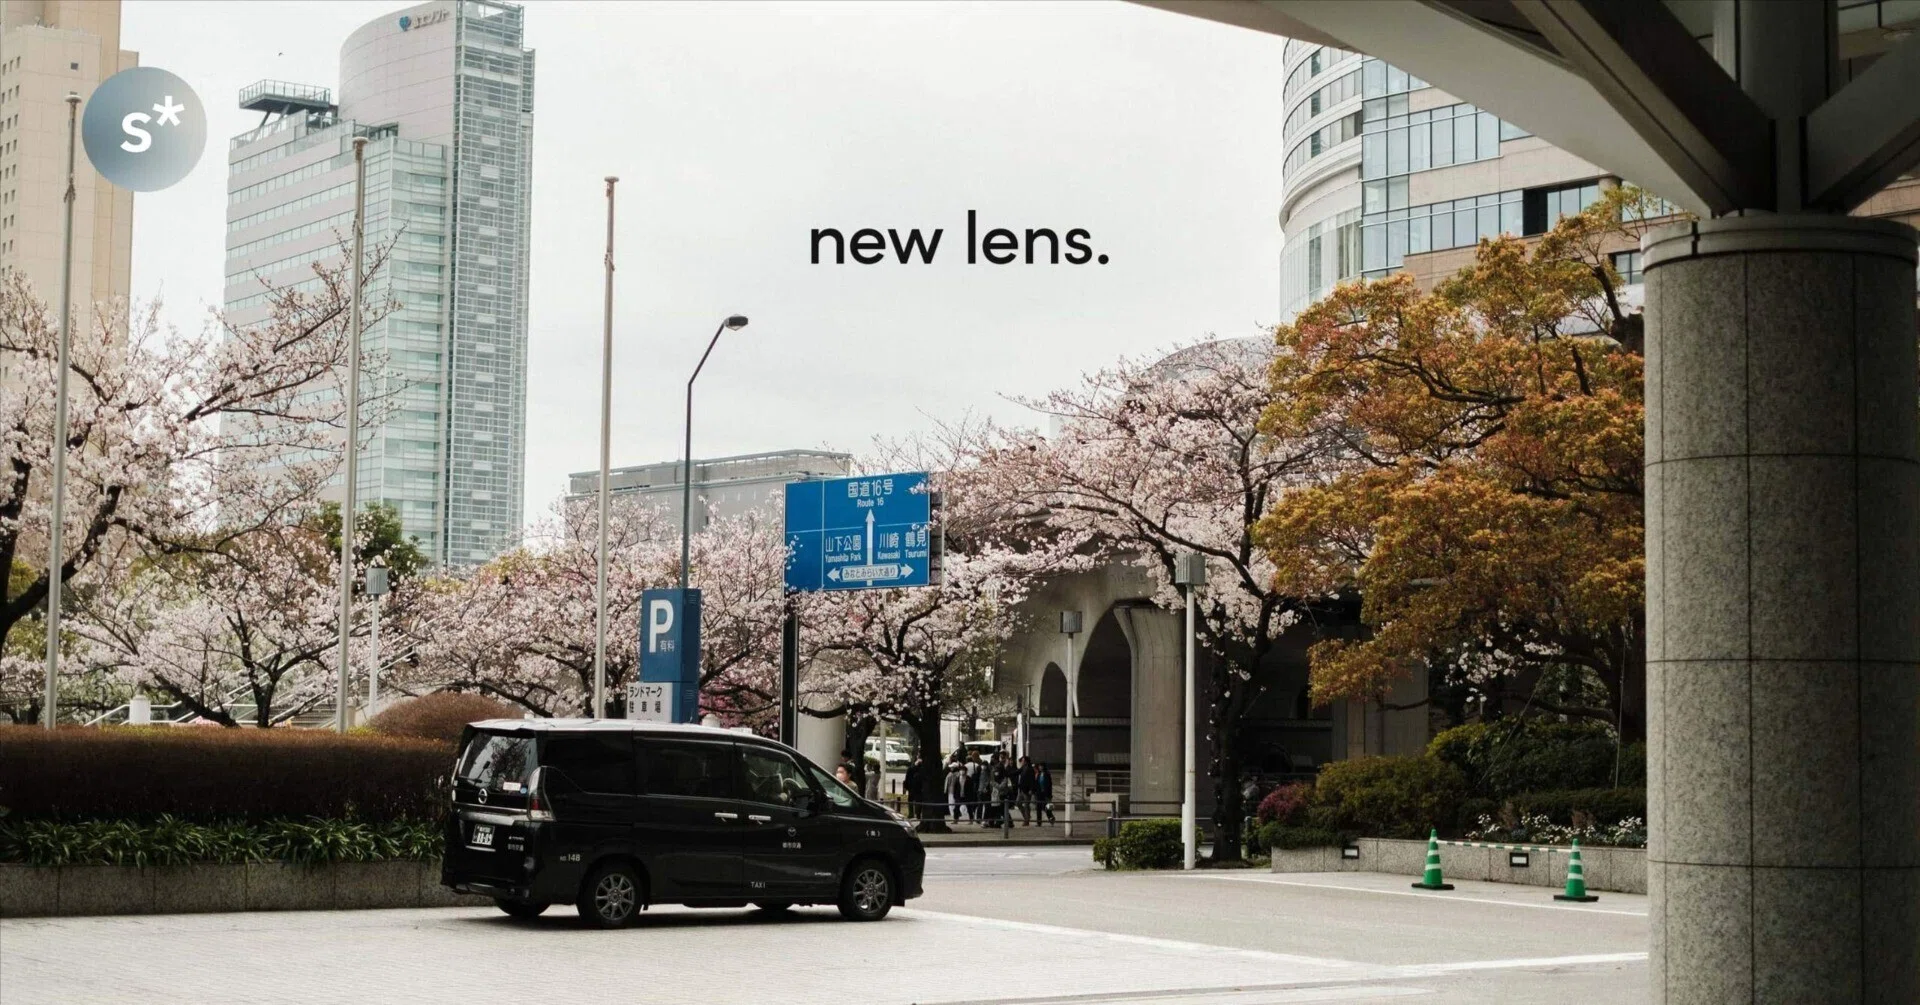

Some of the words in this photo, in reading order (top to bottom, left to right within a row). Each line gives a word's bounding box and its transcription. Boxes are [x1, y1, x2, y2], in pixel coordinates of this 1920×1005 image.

[847, 478, 894, 498] 国道16号
[856, 499, 875, 508] Route
[877, 497, 884, 506] 16
[825, 534, 862, 553] 山下公園
[879, 532, 900, 549] 川崎
[904, 529, 927, 548] 鶴見
[824, 553, 849, 563] Yamashita
[850, 552, 862, 562] Park
[877, 551, 900, 560] Kawasaki
[905, 549, 927, 559] Tsurumi
[843, 567, 896, 580] みなとみらい大通り
[649, 599, 674, 653] P
[629, 686, 662, 698] ランドマーク
[568, 853, 581, 862] 148
[751, 881, 766, 889] TAXI
